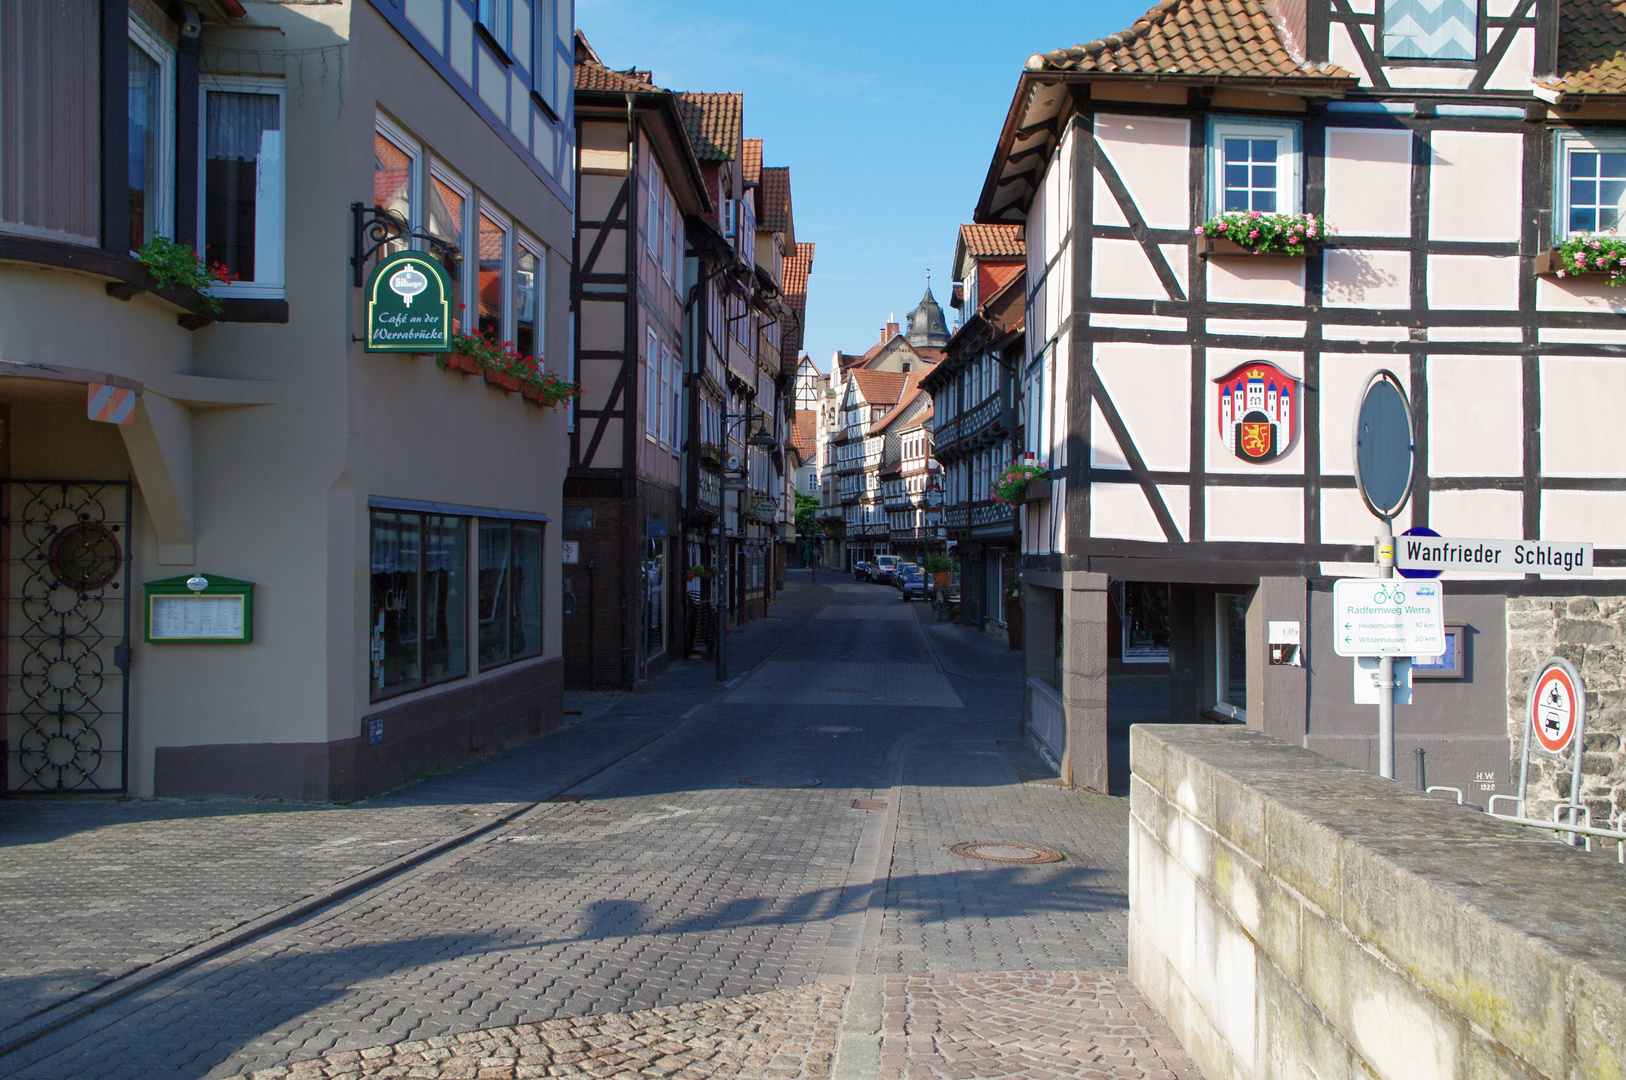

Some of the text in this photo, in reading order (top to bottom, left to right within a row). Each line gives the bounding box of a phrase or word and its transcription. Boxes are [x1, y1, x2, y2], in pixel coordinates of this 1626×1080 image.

[395, 277, 422, 288] Bitburger
[378, 312, 408, 327] Café
[424, 313, 439, 323] der
[373, 328, 443, 340] Werrabrücke
[1407, 541, 1583, 571] Wanfrieder Schlagd
[1347, 606, 1430, 615] Radfernweg Werra
